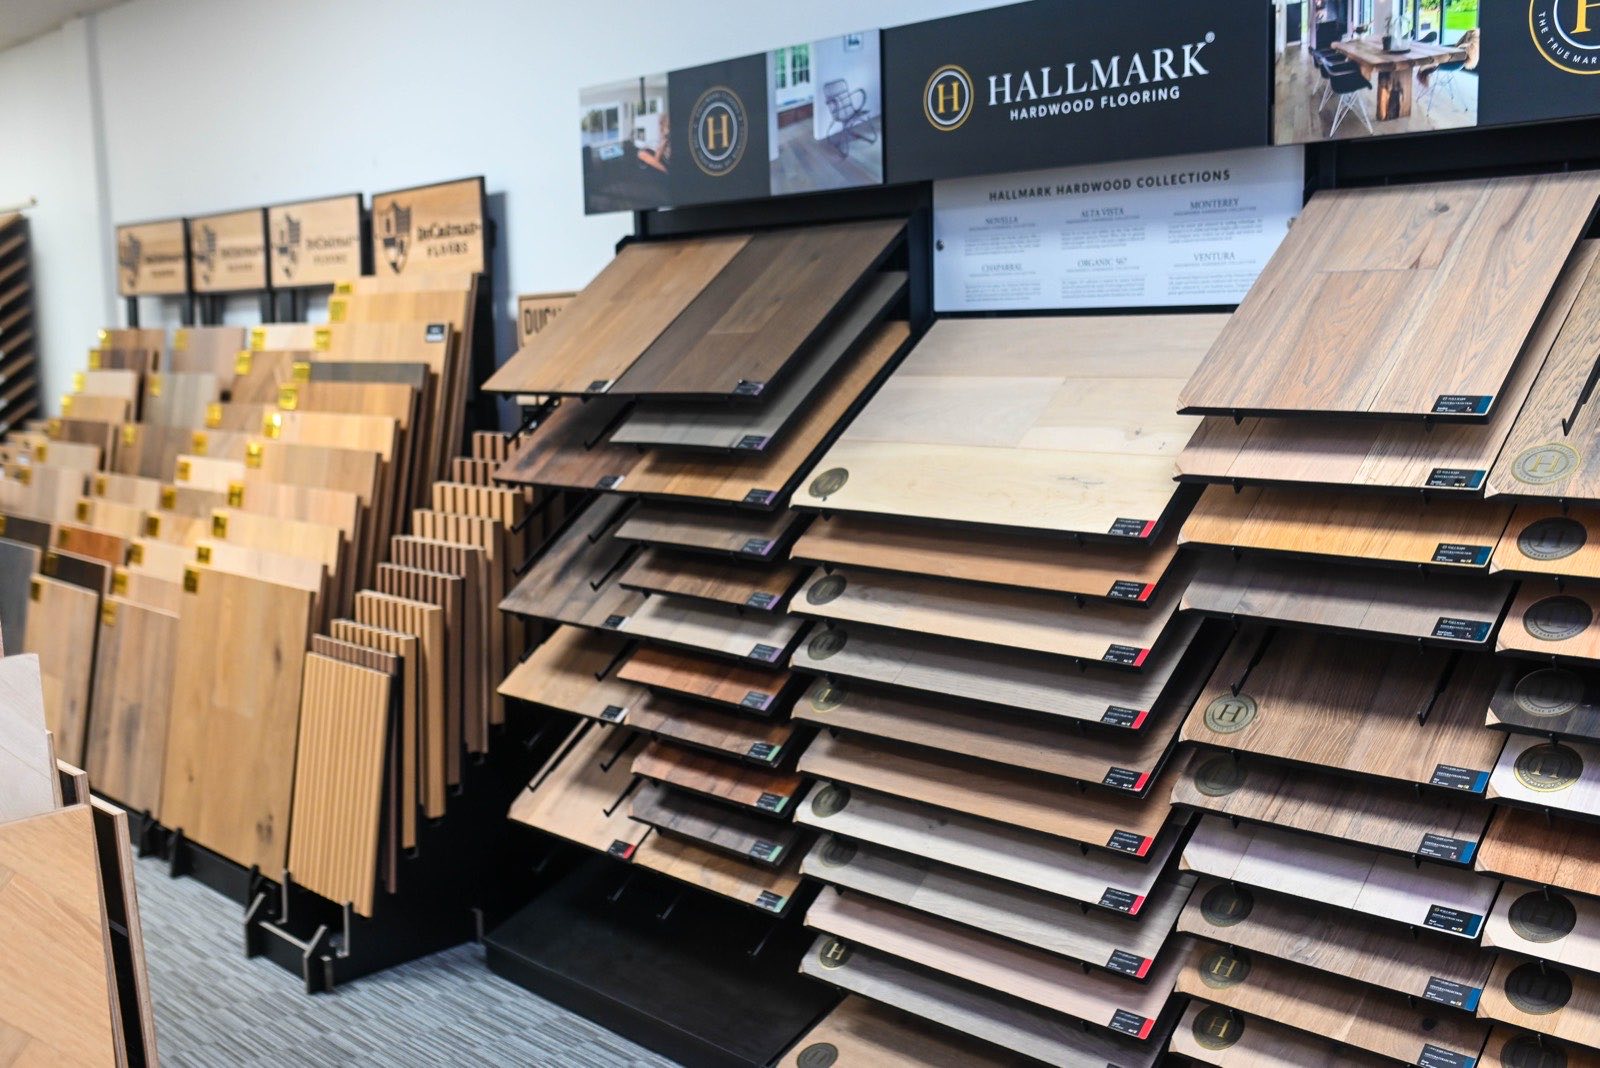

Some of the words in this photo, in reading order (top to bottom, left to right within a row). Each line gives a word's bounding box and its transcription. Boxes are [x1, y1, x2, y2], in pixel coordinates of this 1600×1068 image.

[1539, 11, 1549, 34] THE
[1547, 37, 1570, 60] TRUE
[988, 41, 1210, 106] HALLMARK
[937, 80, 960, 114] H
[1010, 98, 1095, 121] HARDWOOD
[1100, 85, 1181, 109] FLOORING
[706, 112, 730, 151] H
[989, 186, 1052, 203] HALLMARK
[1056, 177, 1133, 196] HARDWOOD
[1137, 168, 1231, 189] COLLECTIONS
[1190, 198, 1240, 211] MONTEREY
[1193, 251, 1236, 263] VENTURA
